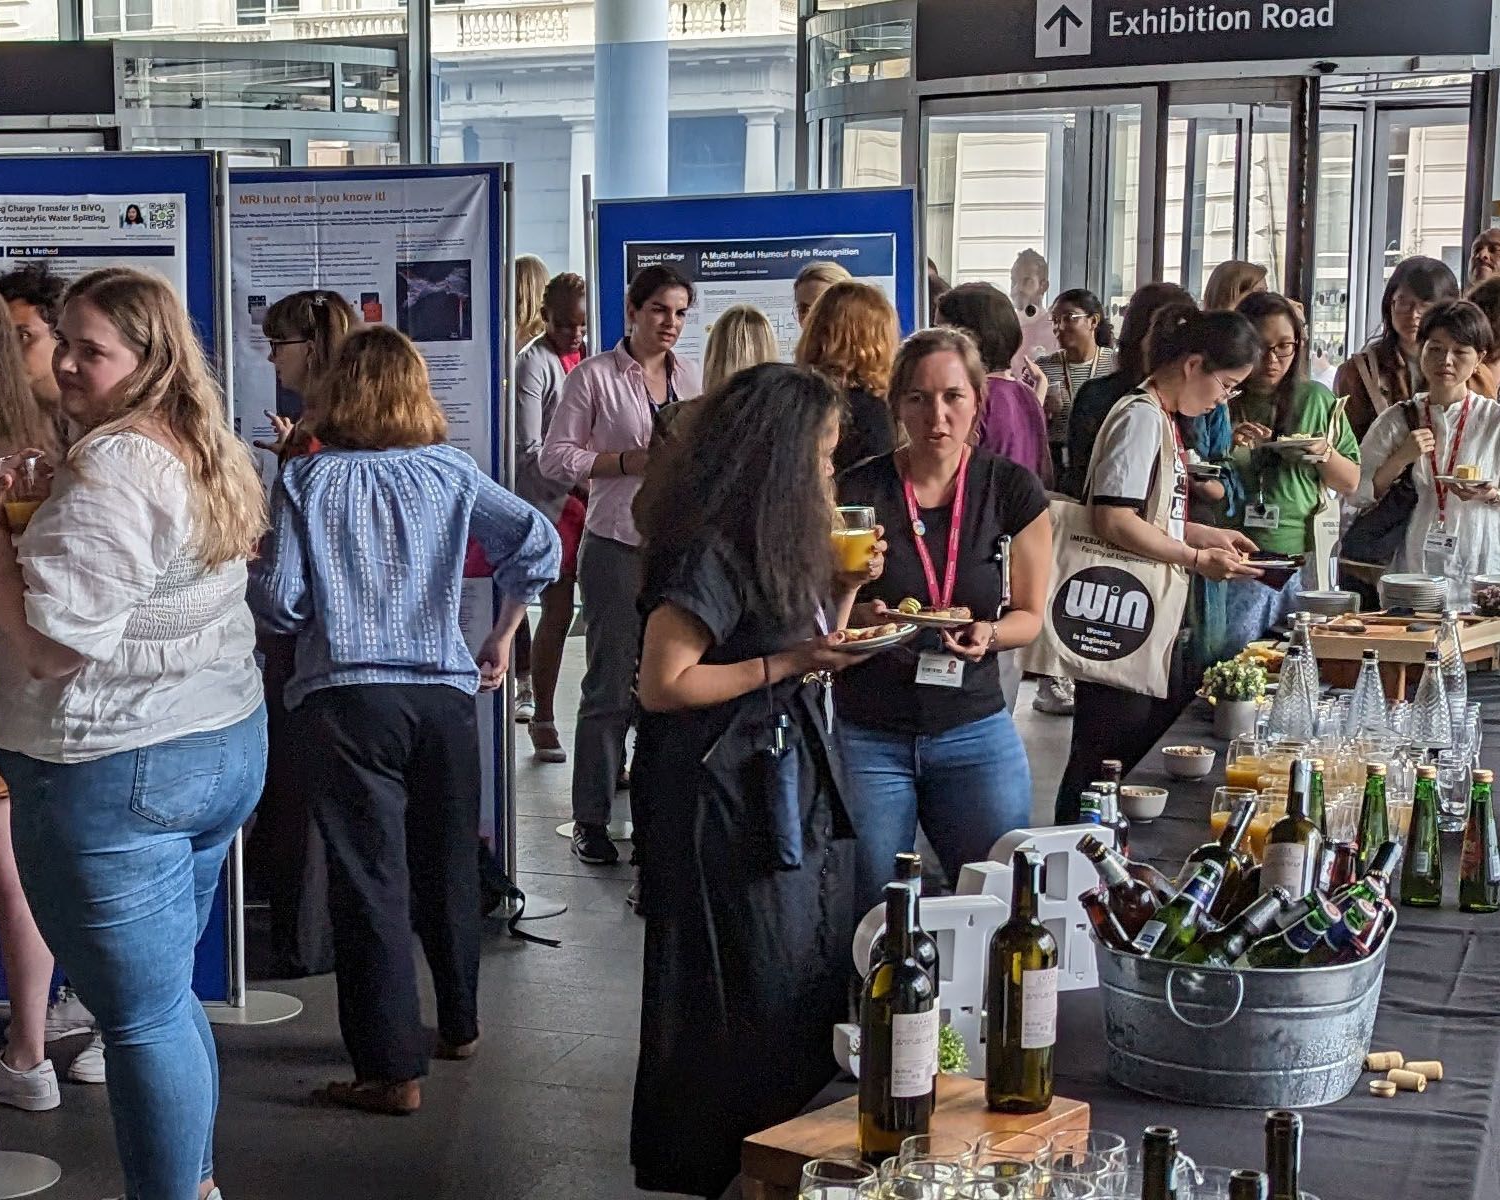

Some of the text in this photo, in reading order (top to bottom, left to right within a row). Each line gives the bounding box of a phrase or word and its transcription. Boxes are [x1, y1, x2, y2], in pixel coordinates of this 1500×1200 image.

[1109, 0, 1334, 36] Exhibition Road
[239, 195, 260, 205] MRI
[263, 194, 280, 204] but
[284, 195, 301, 204] not
[304, 195, 316, 203] as
[319, 195, 340, 205] you
[343, 192, 371, 201] know
[8, 205, 36, 213] Charge
[38, 204, 70, 212] Transfer
[48, 214, 70, 222] Water
[73, 214, 105, 223] Splitting
[637, 253, 685, 262] Imperial College
[791, 249, 810, 258] Style
[813, 248, 859, 257] Recognition
[701, 260, 735, 268] Platform
[1081, 635, 1121, 649] Engineering
